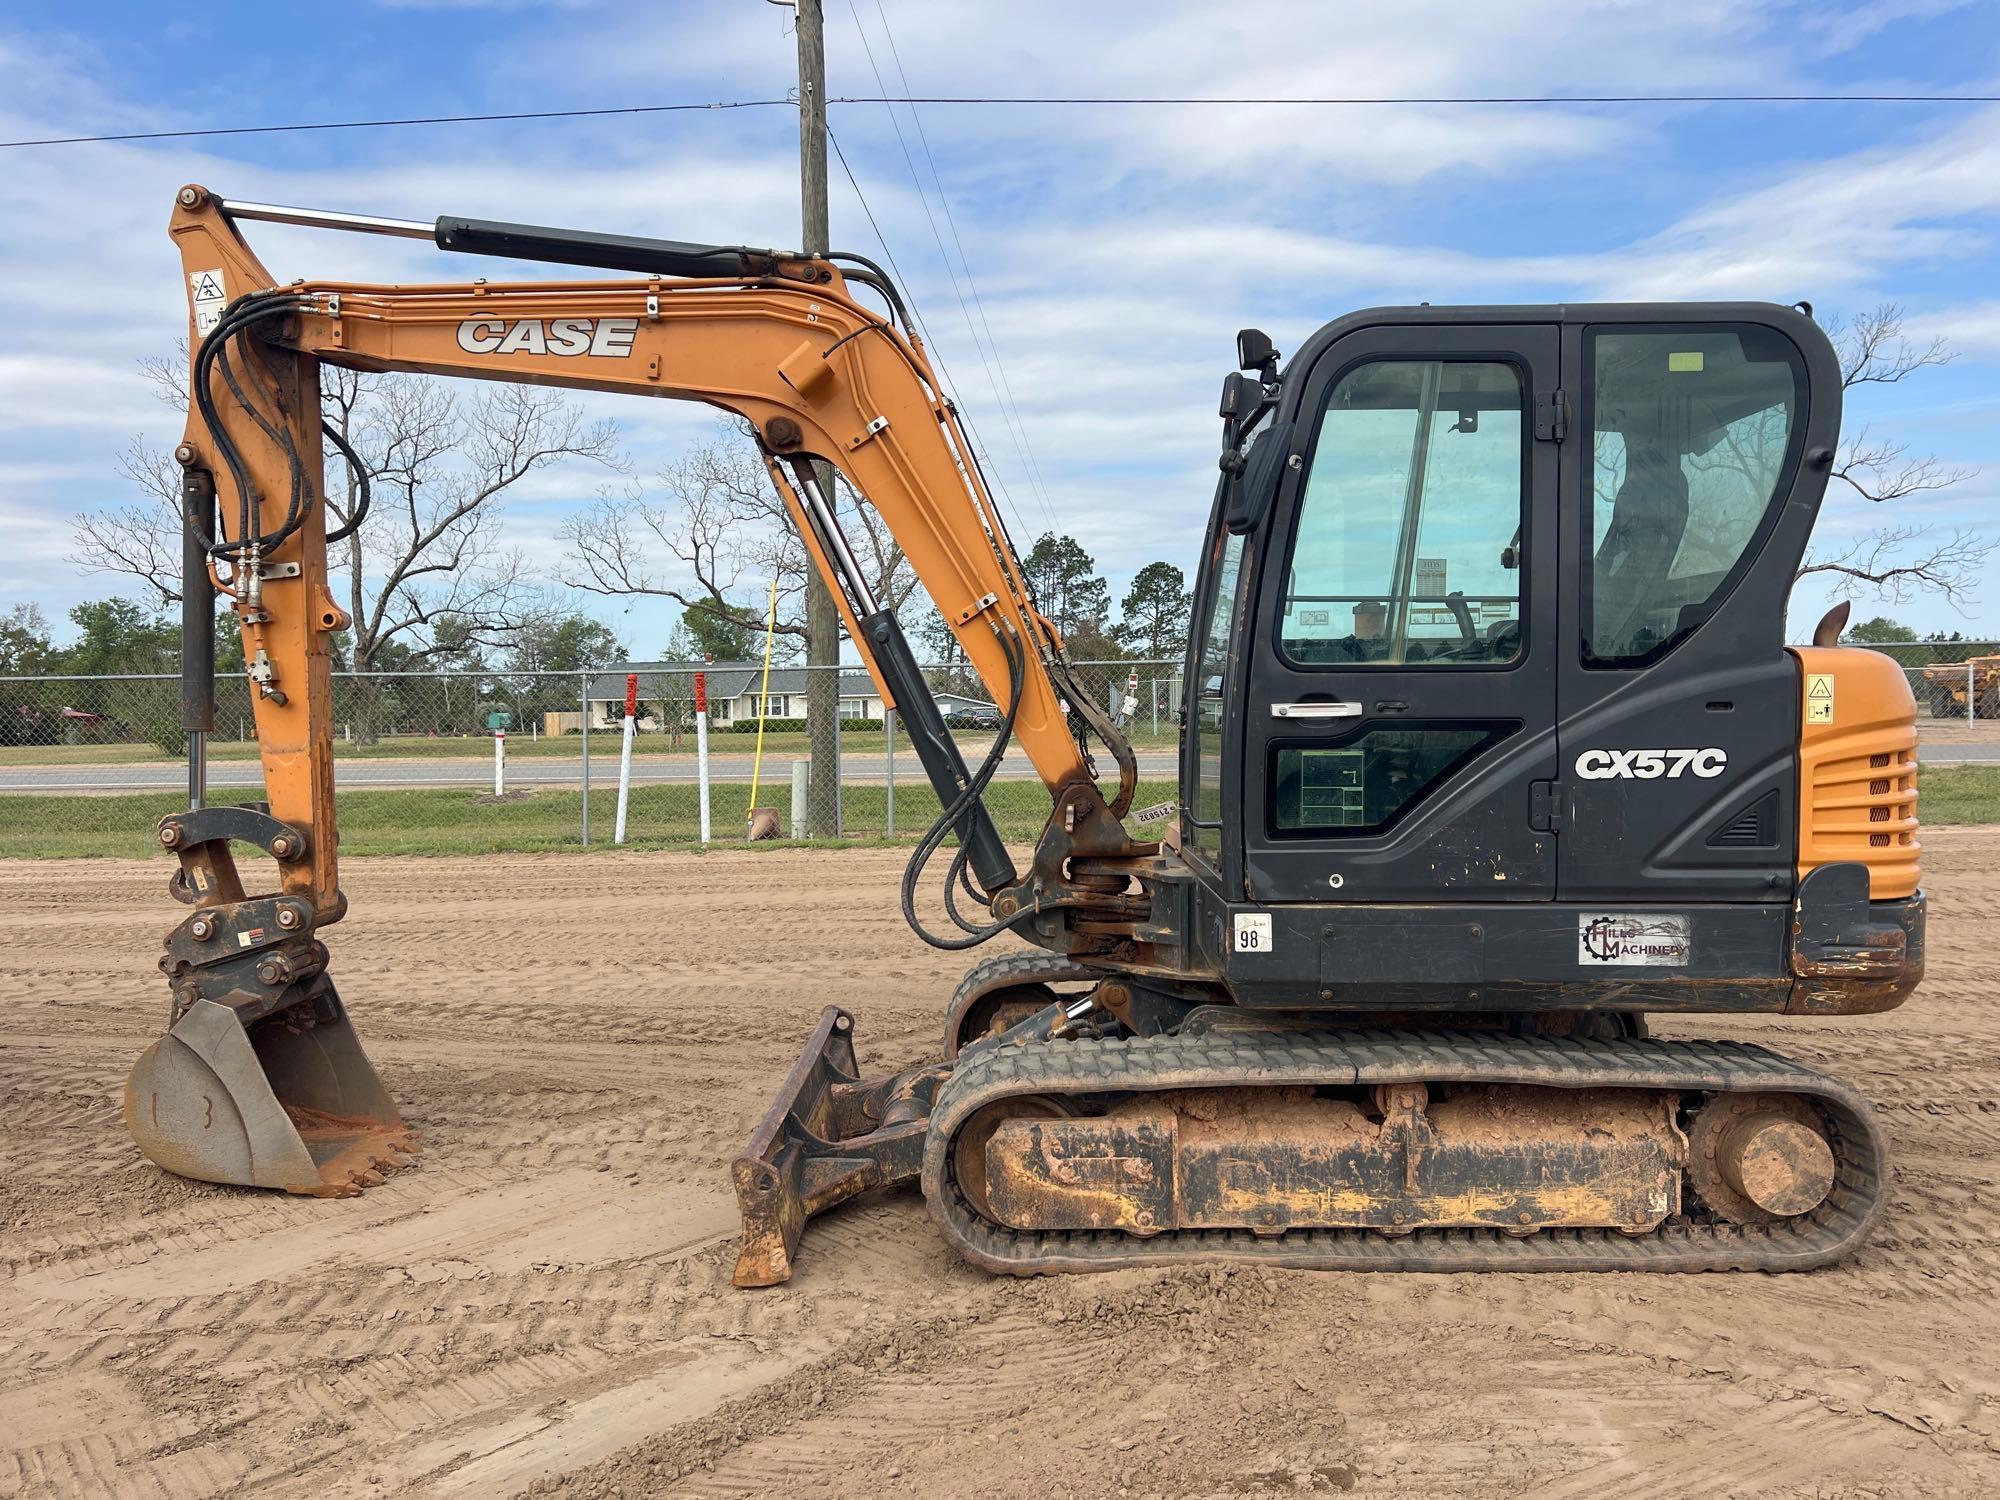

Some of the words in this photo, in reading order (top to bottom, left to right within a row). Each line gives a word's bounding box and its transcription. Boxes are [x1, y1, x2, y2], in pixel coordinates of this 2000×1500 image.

[456, 311, 640, 358] CASE
[1574, 747, 1728, 780] CX57C
[1240, 930, 1258, 948] 98
